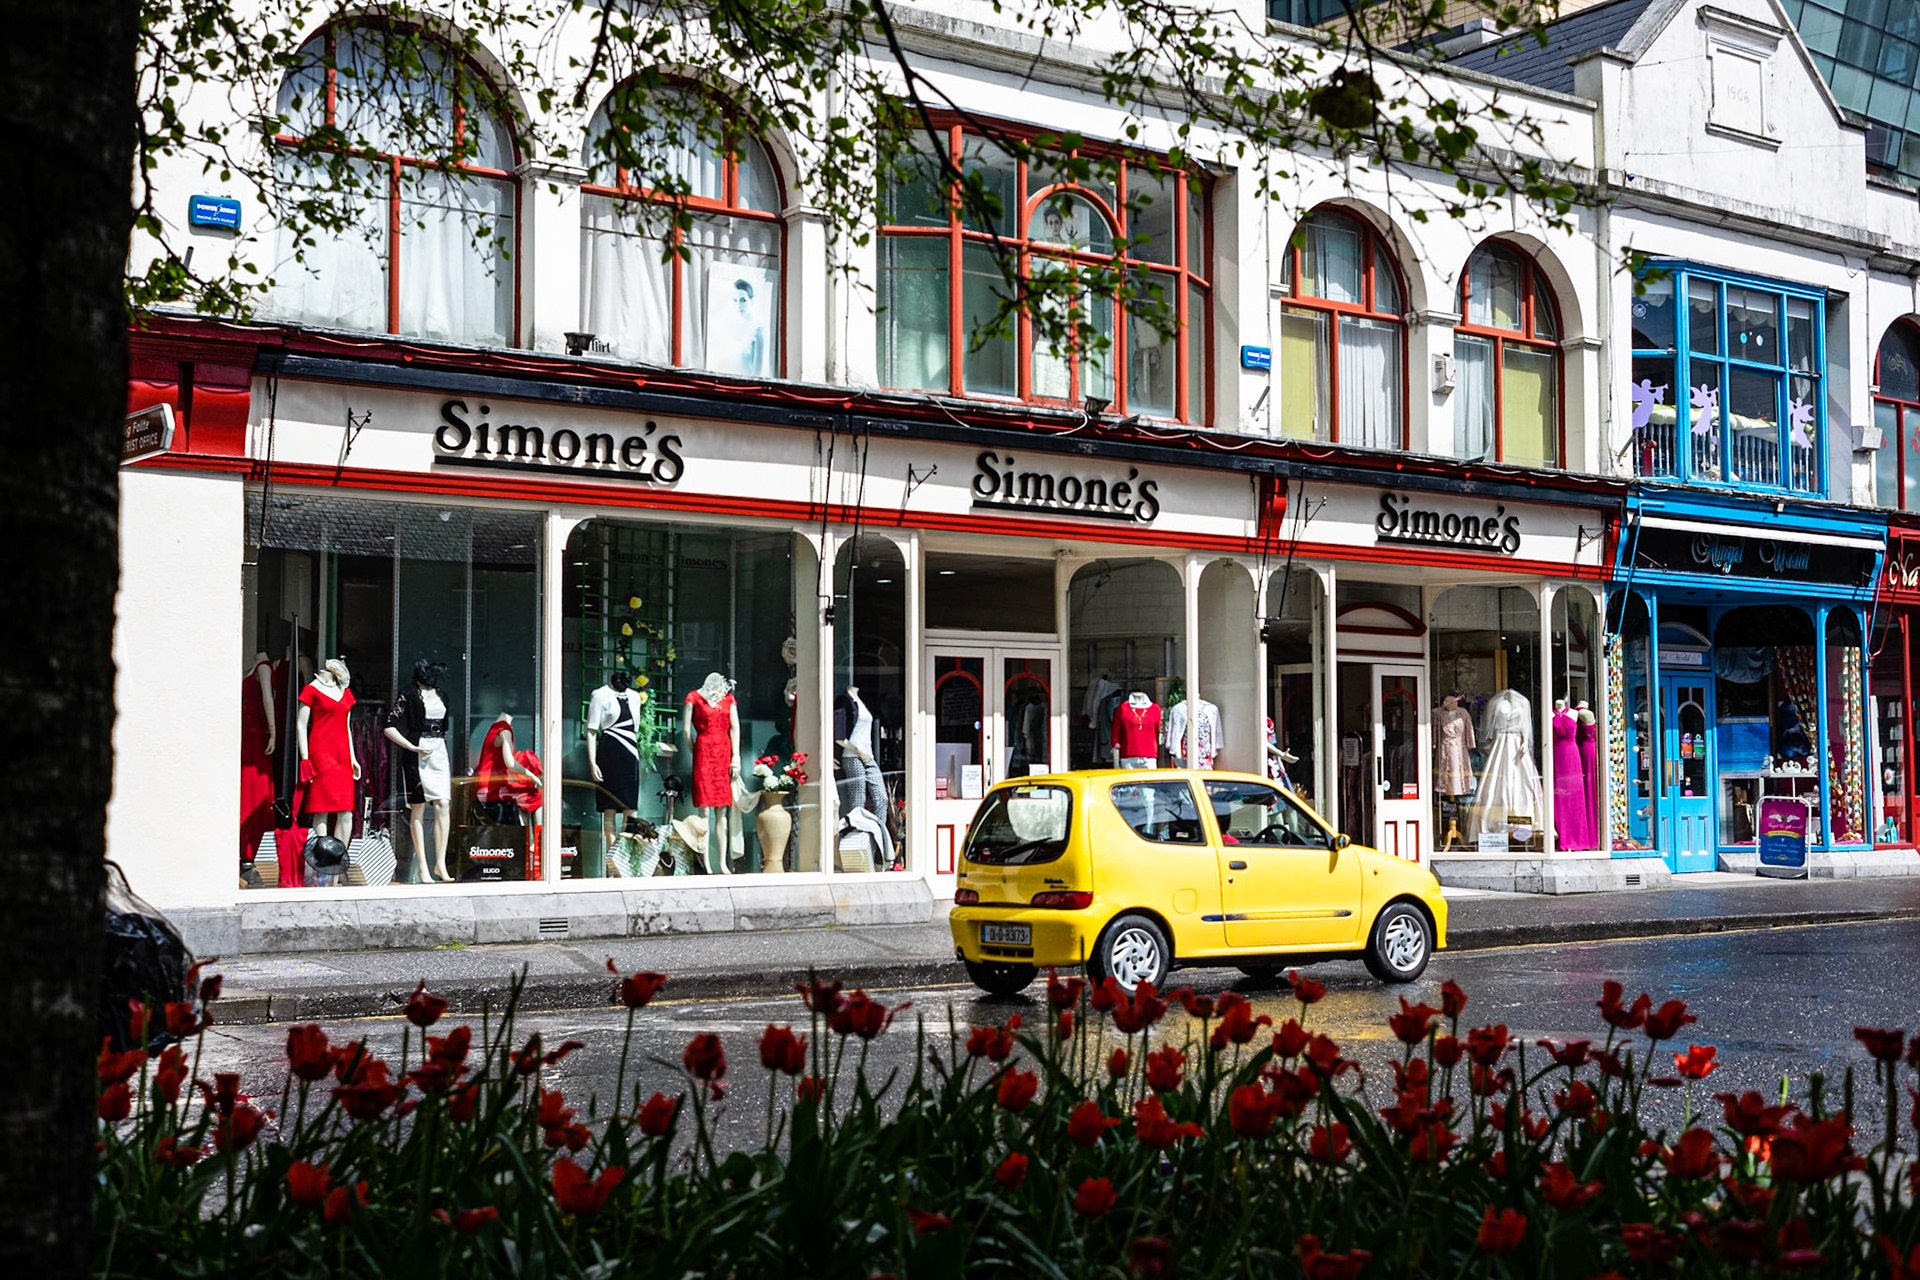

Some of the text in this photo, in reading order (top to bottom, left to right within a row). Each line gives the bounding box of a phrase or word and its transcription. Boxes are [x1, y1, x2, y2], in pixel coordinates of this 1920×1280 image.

[1727, 85, 1750, 104] 1906
[139, 432, 158, 449] OFFICE
[435, 400, 685, 484] Simone's
[973, 452, 1160, 522] Simone's
[1377, 492, 1521, 553] Simone's
[469, 846, 515, 859] Simone's
